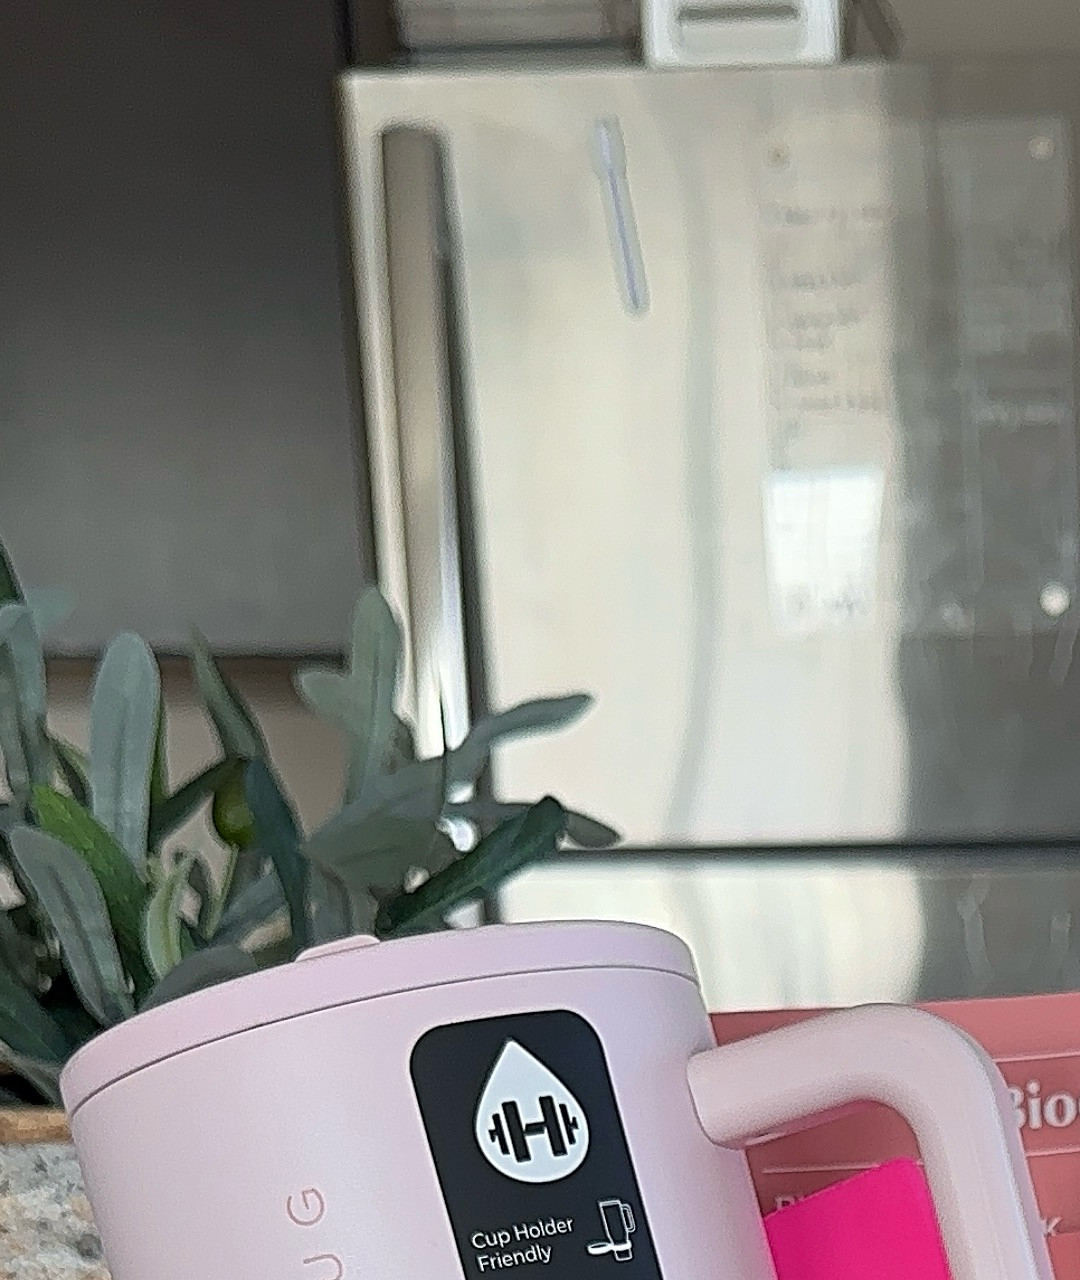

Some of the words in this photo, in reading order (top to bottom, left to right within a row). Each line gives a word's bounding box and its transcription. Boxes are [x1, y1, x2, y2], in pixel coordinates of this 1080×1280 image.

[471, 1228, 511, 1251] Cup
[514, 1215, 574, 1242] Holder
[477, 1243, 553, 1272] Friendly
